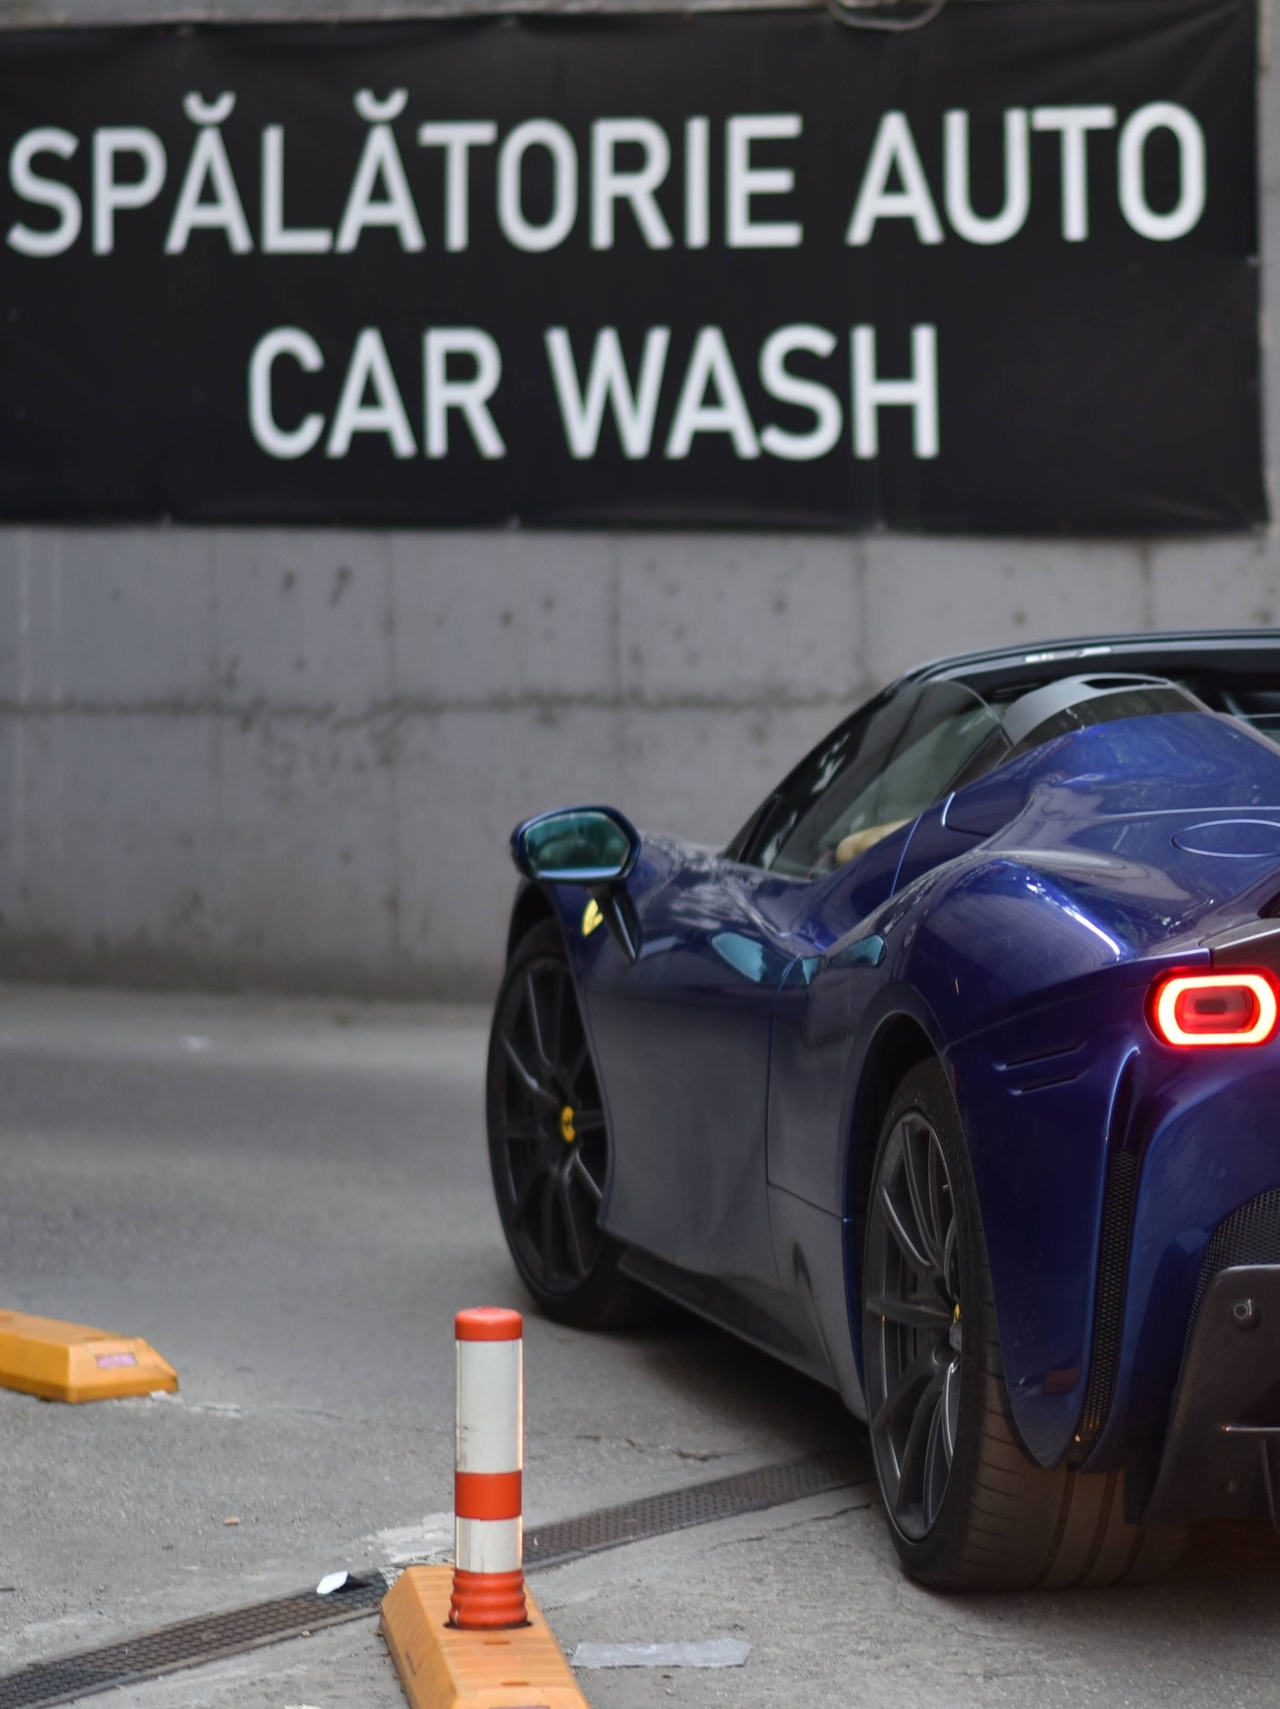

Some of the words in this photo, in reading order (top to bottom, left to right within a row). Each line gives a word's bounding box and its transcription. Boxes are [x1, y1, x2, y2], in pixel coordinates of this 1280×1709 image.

[7, 89, 803, 257] SPĂLĂTORIE
[846, 102, 1207, 246] AUTO
[248, 327, 506, 459] CAR
[545, 323, 940, 460] WASH
